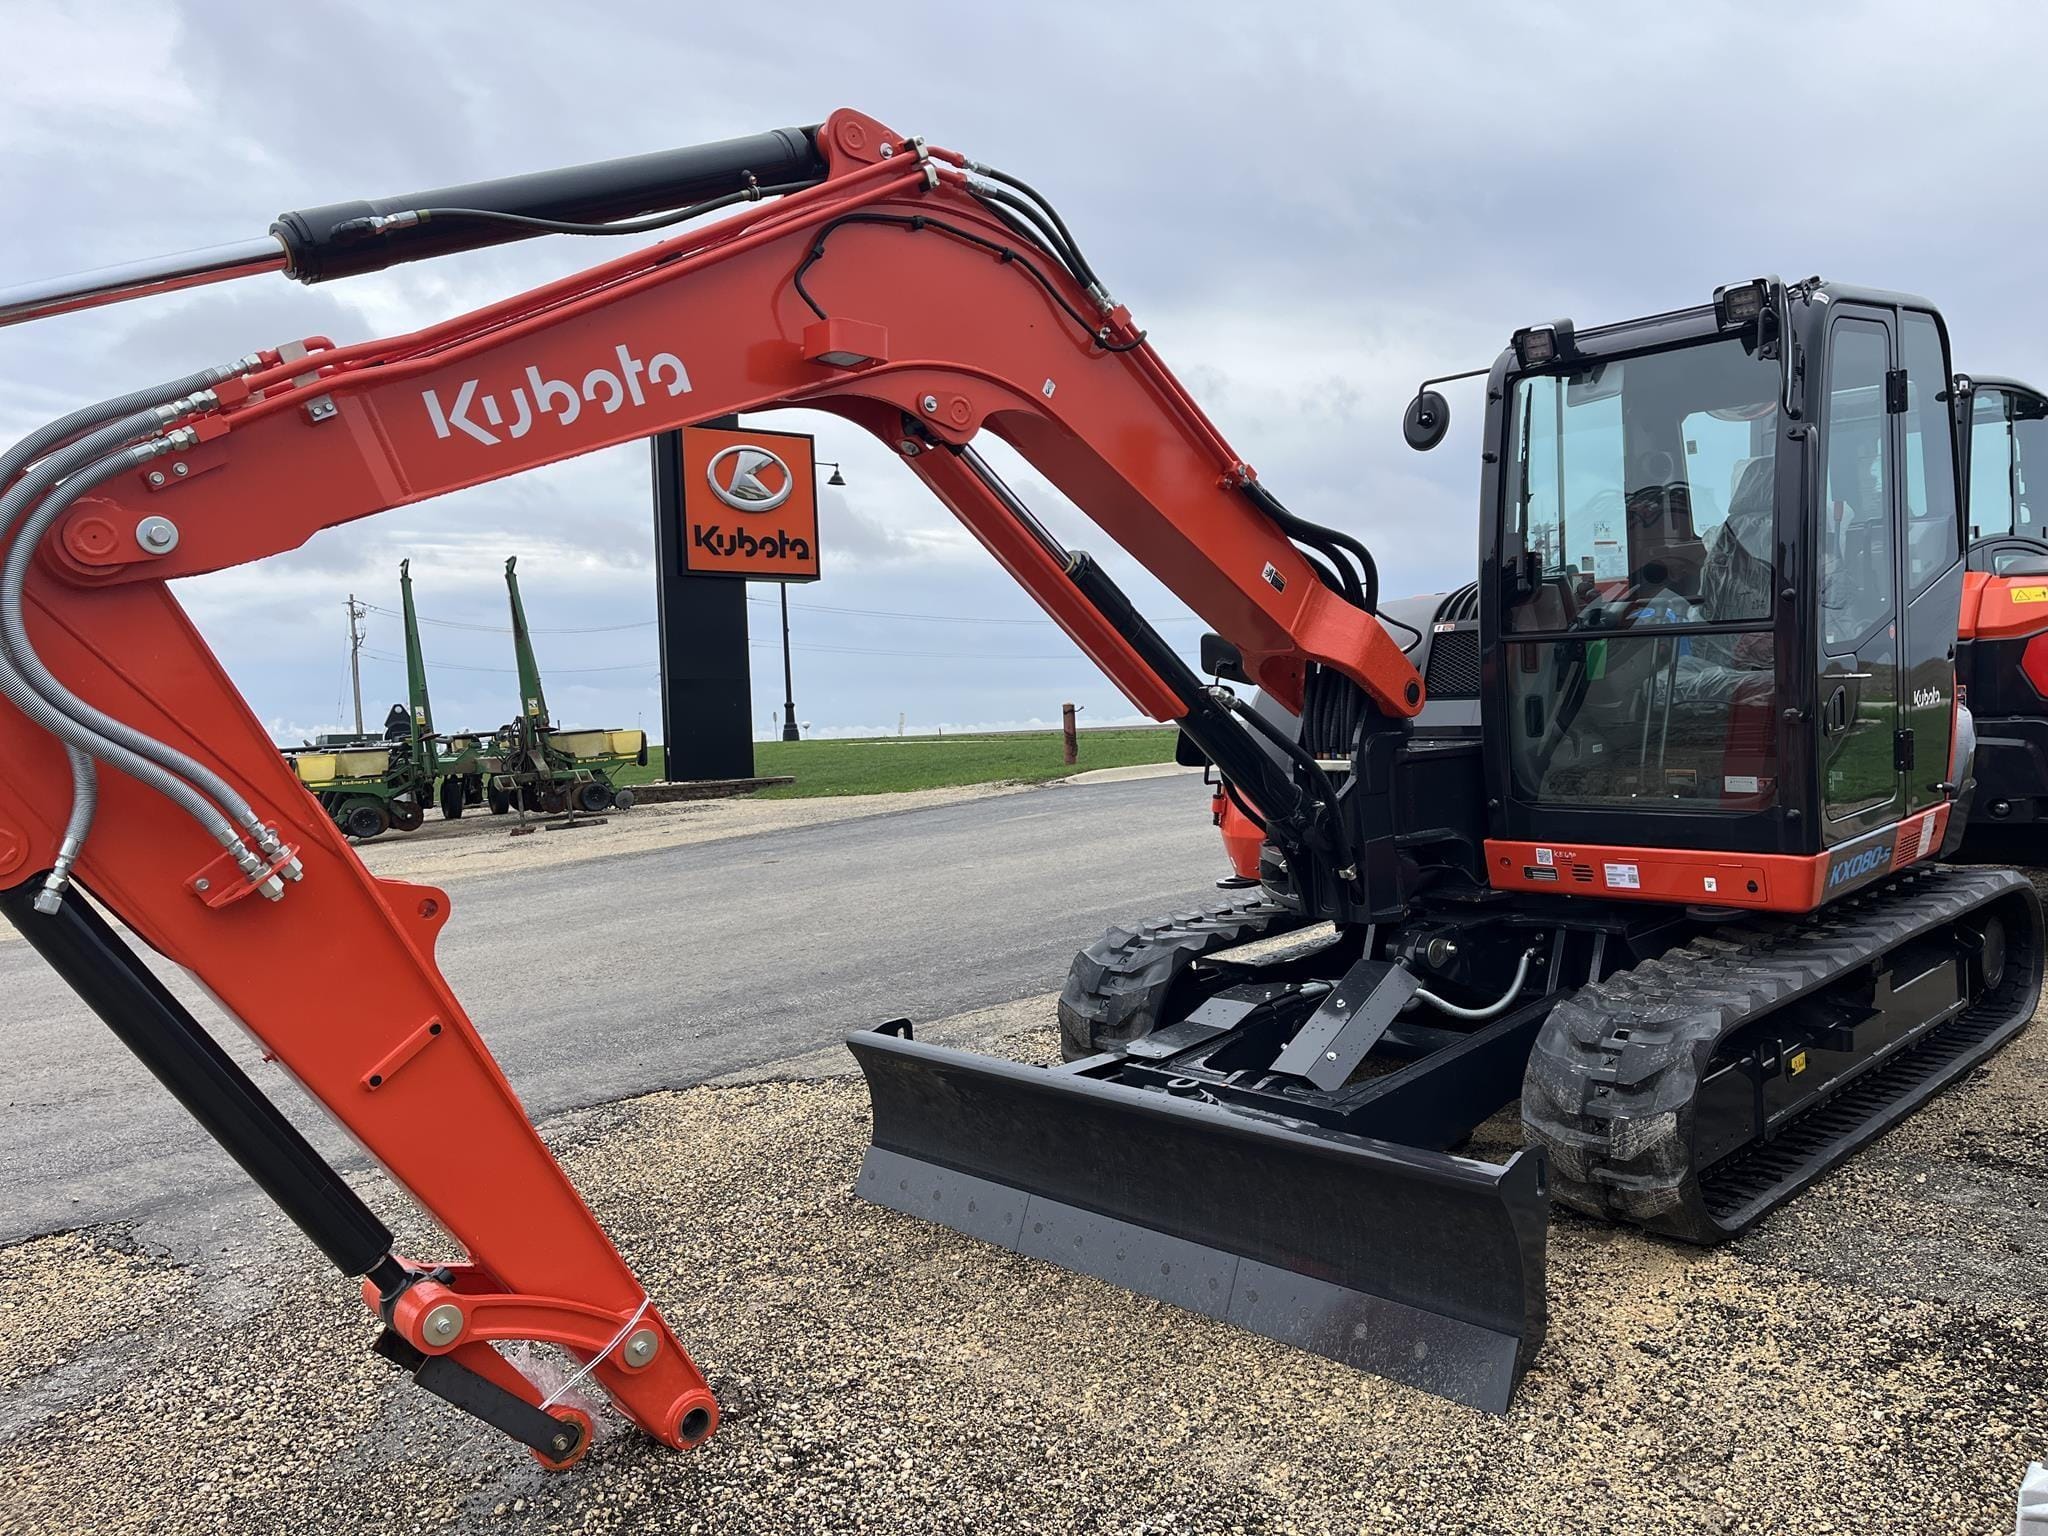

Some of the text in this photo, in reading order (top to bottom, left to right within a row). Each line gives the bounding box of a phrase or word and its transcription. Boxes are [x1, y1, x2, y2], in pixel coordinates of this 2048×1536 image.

[421, 344, 693, 446] Kubota
[694, 524, 810, 560] Kubota
[1913, 686, 1941, 708] Kubota
[1829, 846, 1892, 887] KX080-5
